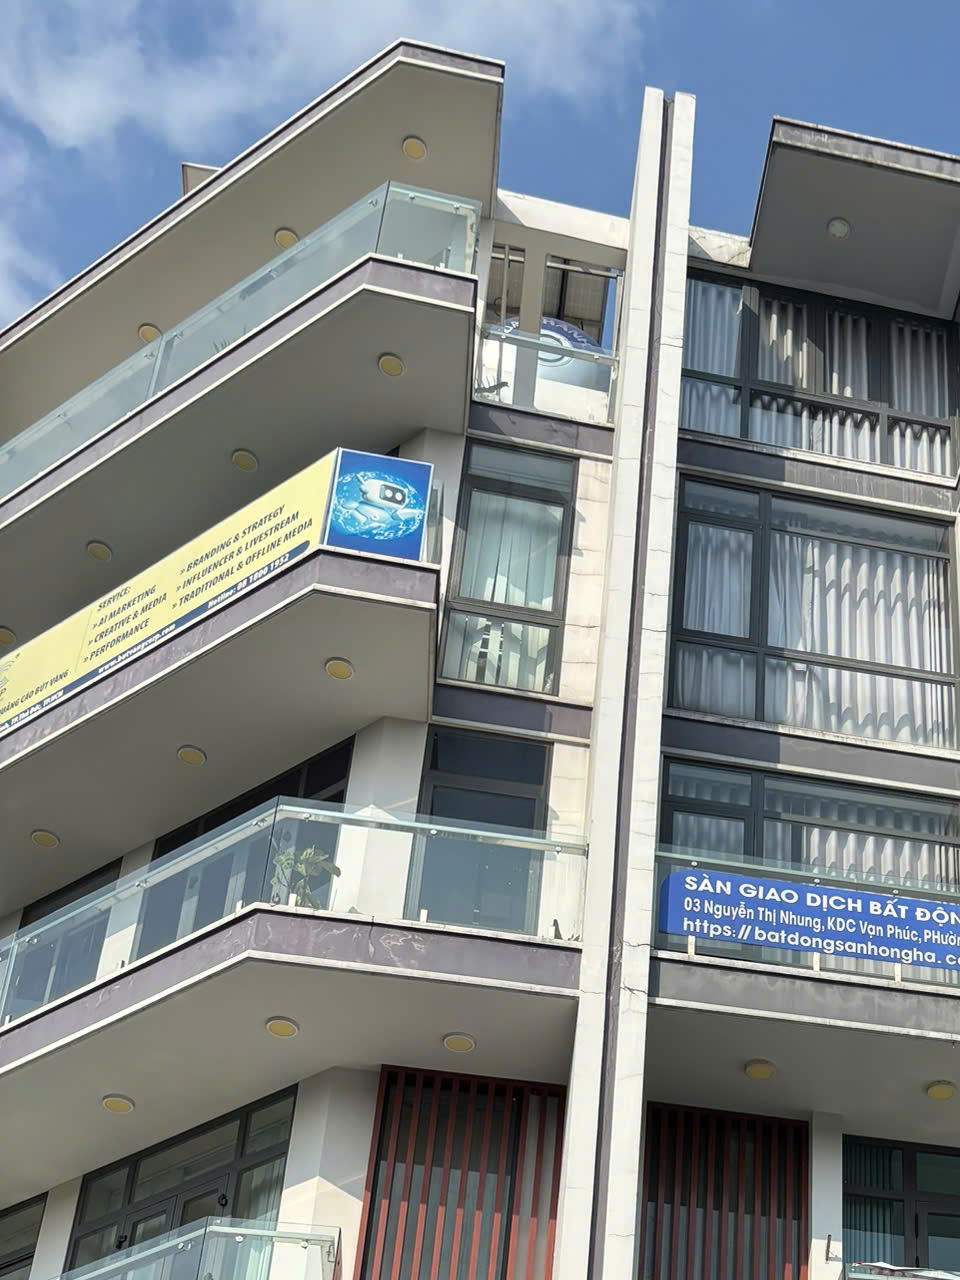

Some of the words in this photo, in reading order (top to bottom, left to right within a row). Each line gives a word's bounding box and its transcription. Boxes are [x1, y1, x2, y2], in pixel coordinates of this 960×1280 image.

[178, 566, 235, 606] TRADITIONAL
[245, 537, 282, 566] OFFLINE
[283, 518, 313, 543] MEDIA
[182, 551, 235, 589] INFLUENCER
[244, 511, 299, 550] LIVESTREAM
[186, 538, 232, 573] BRANDING
[241, 504, 285, 538] STRATEGY
[94, 614, 131, 643] CREATIVE
[140, 592, 167, 616] MEDIA
[108, 585, 157, 622] MARKETING
[89, 618, 150, 661] PERFORMANCE
[684, 873, 732, 895] SÀN
[739, 883, 798, 904] GIAO
[806, 892, 862, 913] DỊCH
[870, 897, 908, 919] BẤT
[684, 897, 701, 912] 03
[703, 900, 755, 921] Nguyễn
[758, 907, 777, 926] Thị
[780, 911, 825, 932] Nhung,
[827, 916, 857, 933] KDC
[859, 921, 884, 940] Vạn
[887, 923, 922, 944] Phúc,
